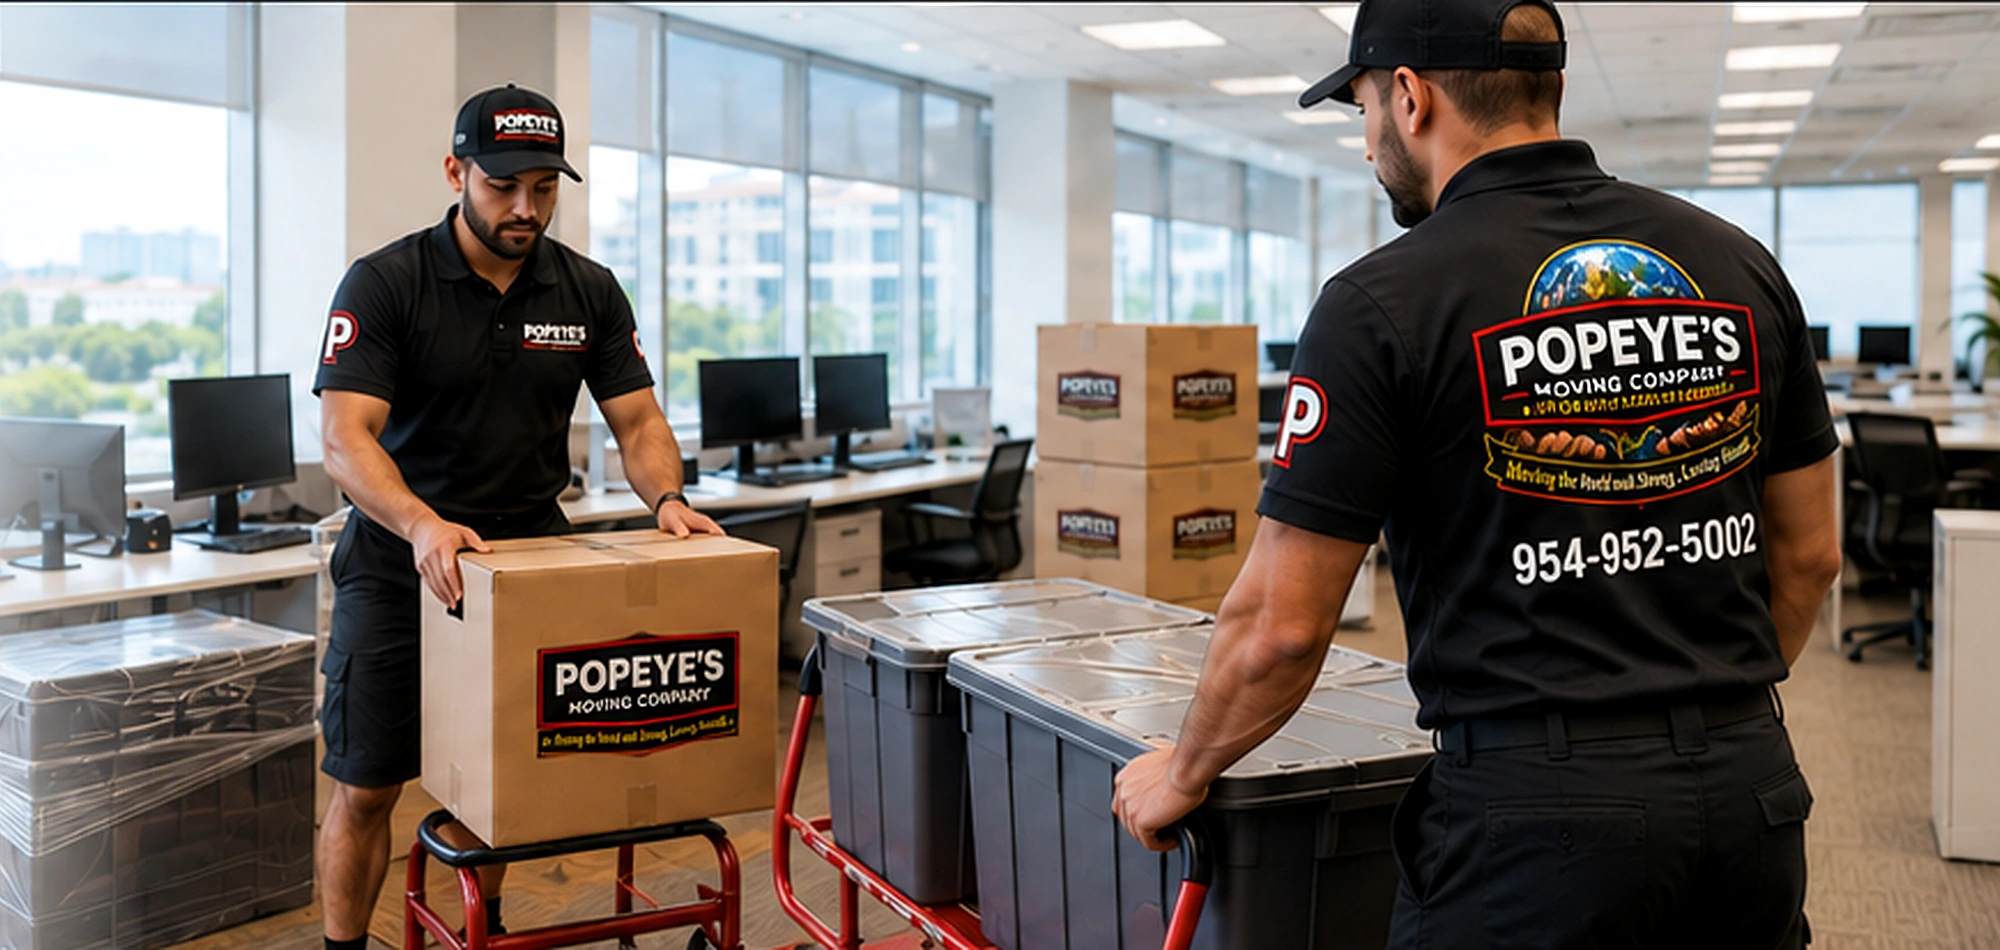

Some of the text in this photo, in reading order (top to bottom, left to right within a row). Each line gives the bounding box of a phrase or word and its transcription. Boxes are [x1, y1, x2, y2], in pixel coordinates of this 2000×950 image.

[324, 316, 353, 358] P
[1499, 315, 1741, 387] POPEYE'S
[1276, 383, 1322, 459] P
[1512, 513, 1757, 585] 954-952-5002
[555, 648, 725, 697] POPEYE'S
